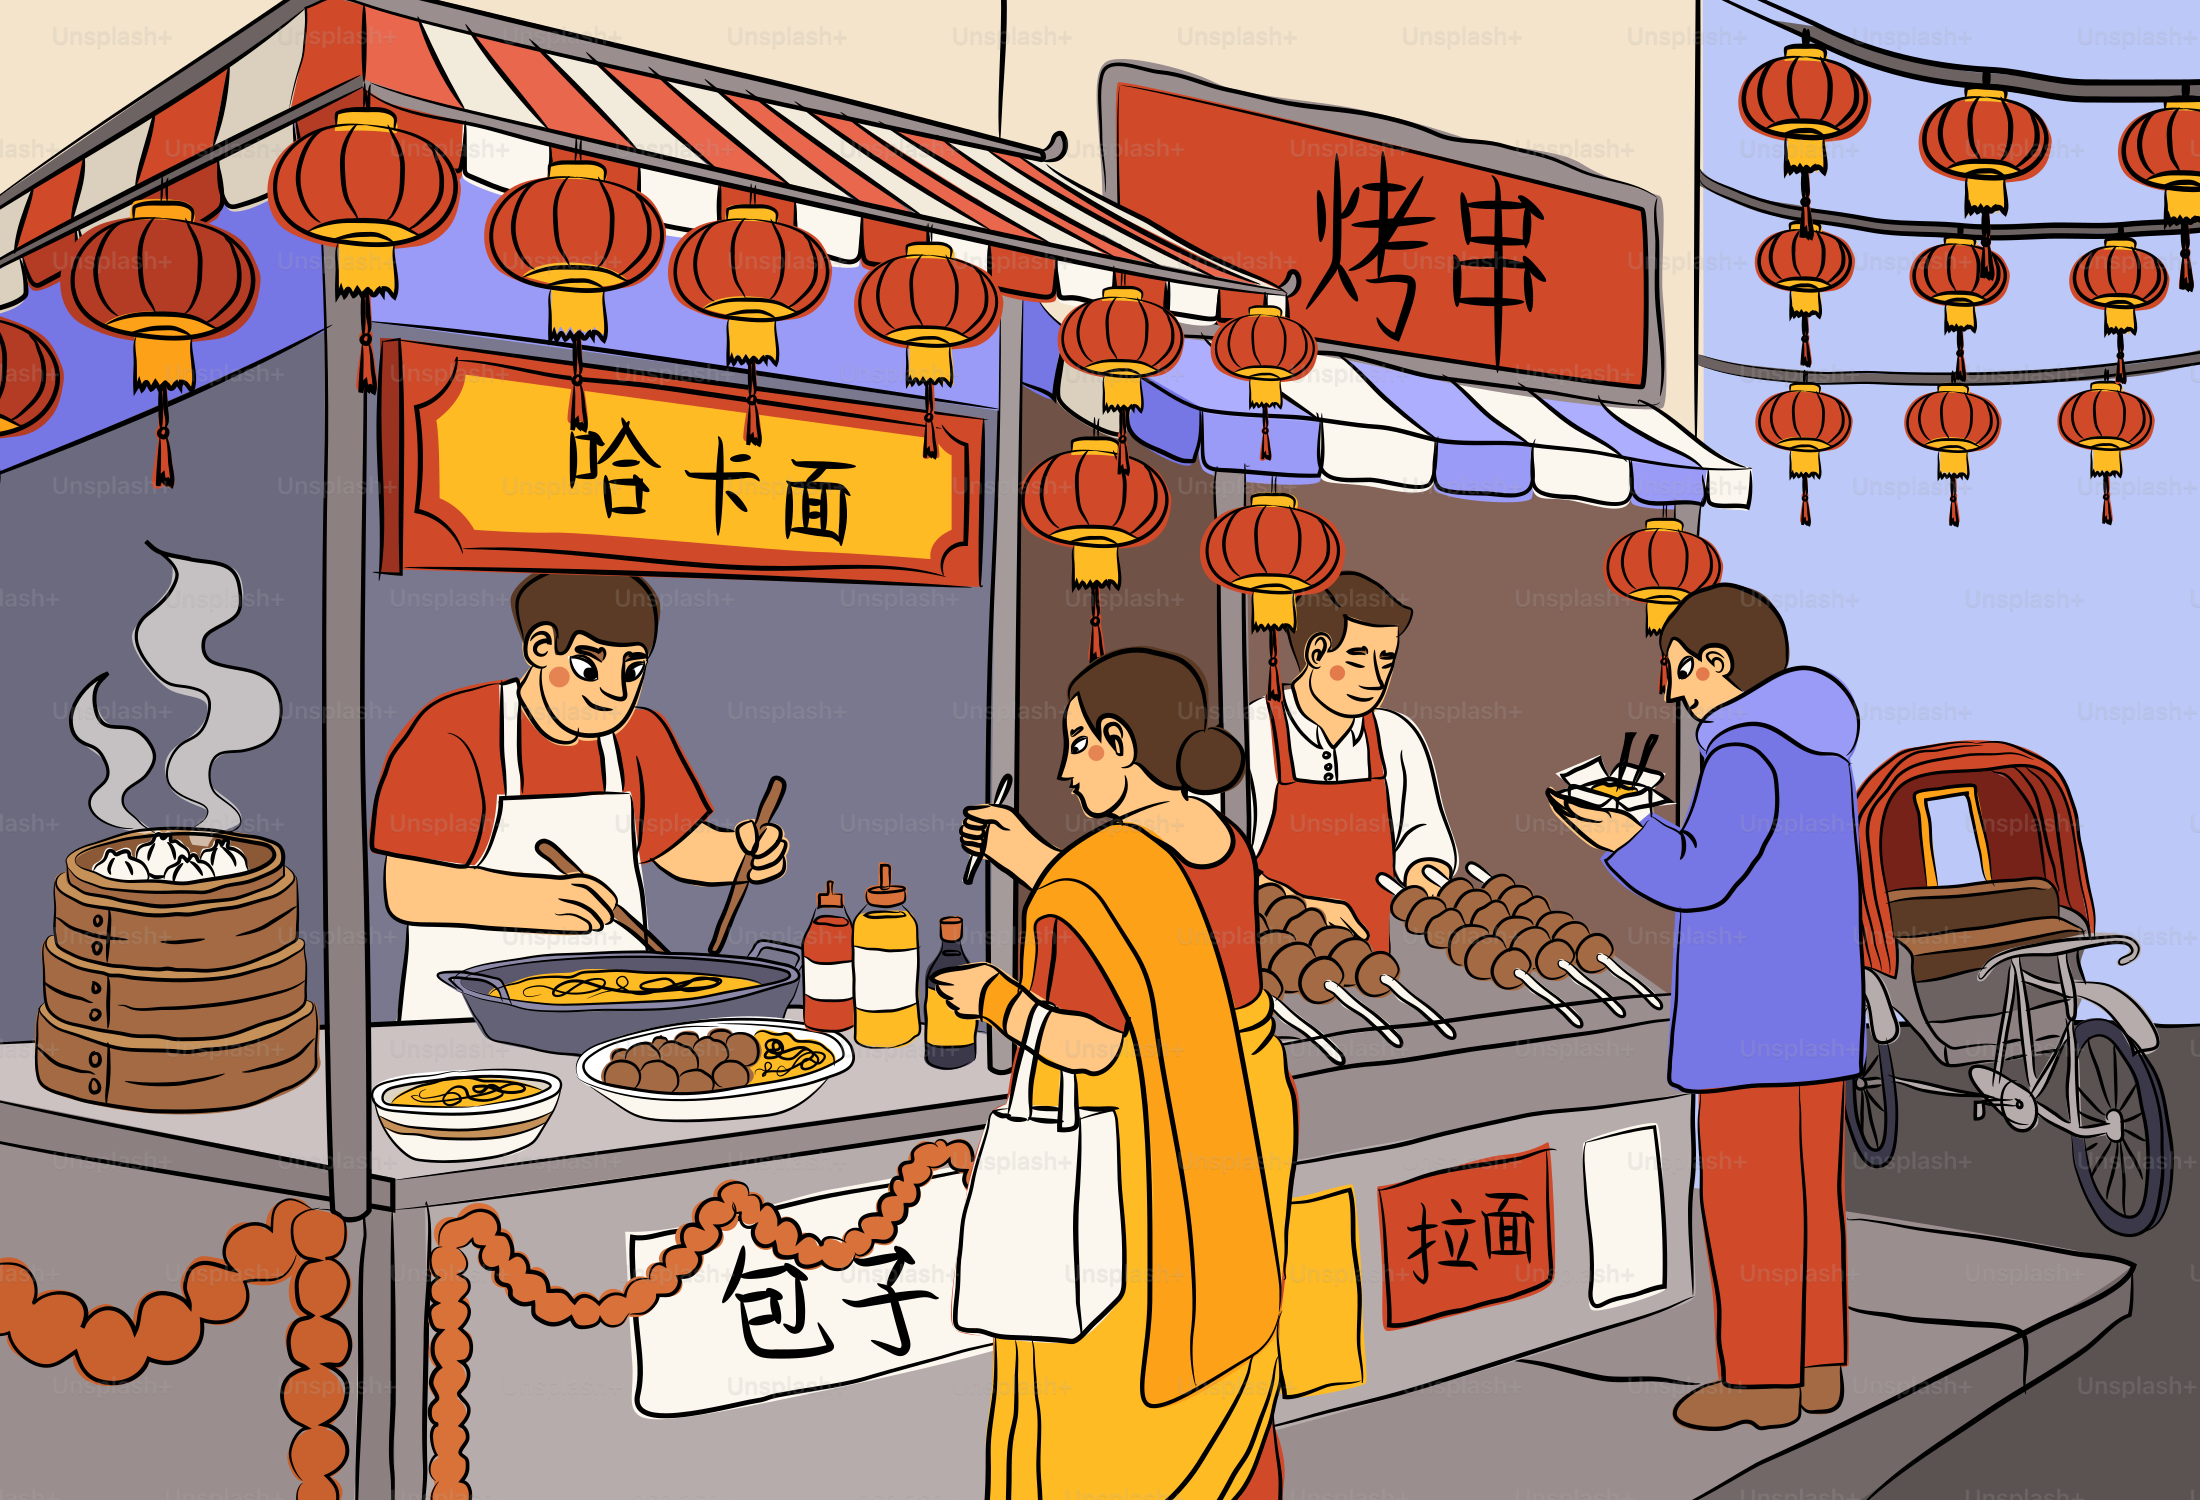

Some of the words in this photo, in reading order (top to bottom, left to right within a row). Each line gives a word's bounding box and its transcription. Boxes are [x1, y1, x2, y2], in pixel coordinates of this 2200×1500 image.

[1305, 151, 1547, 374] 烤串
[570, 416, 857, 547] 哈卡面
[1406, 1192, 1535, 1285] 拉面
[722, 1245, 940, 1360] 包子
